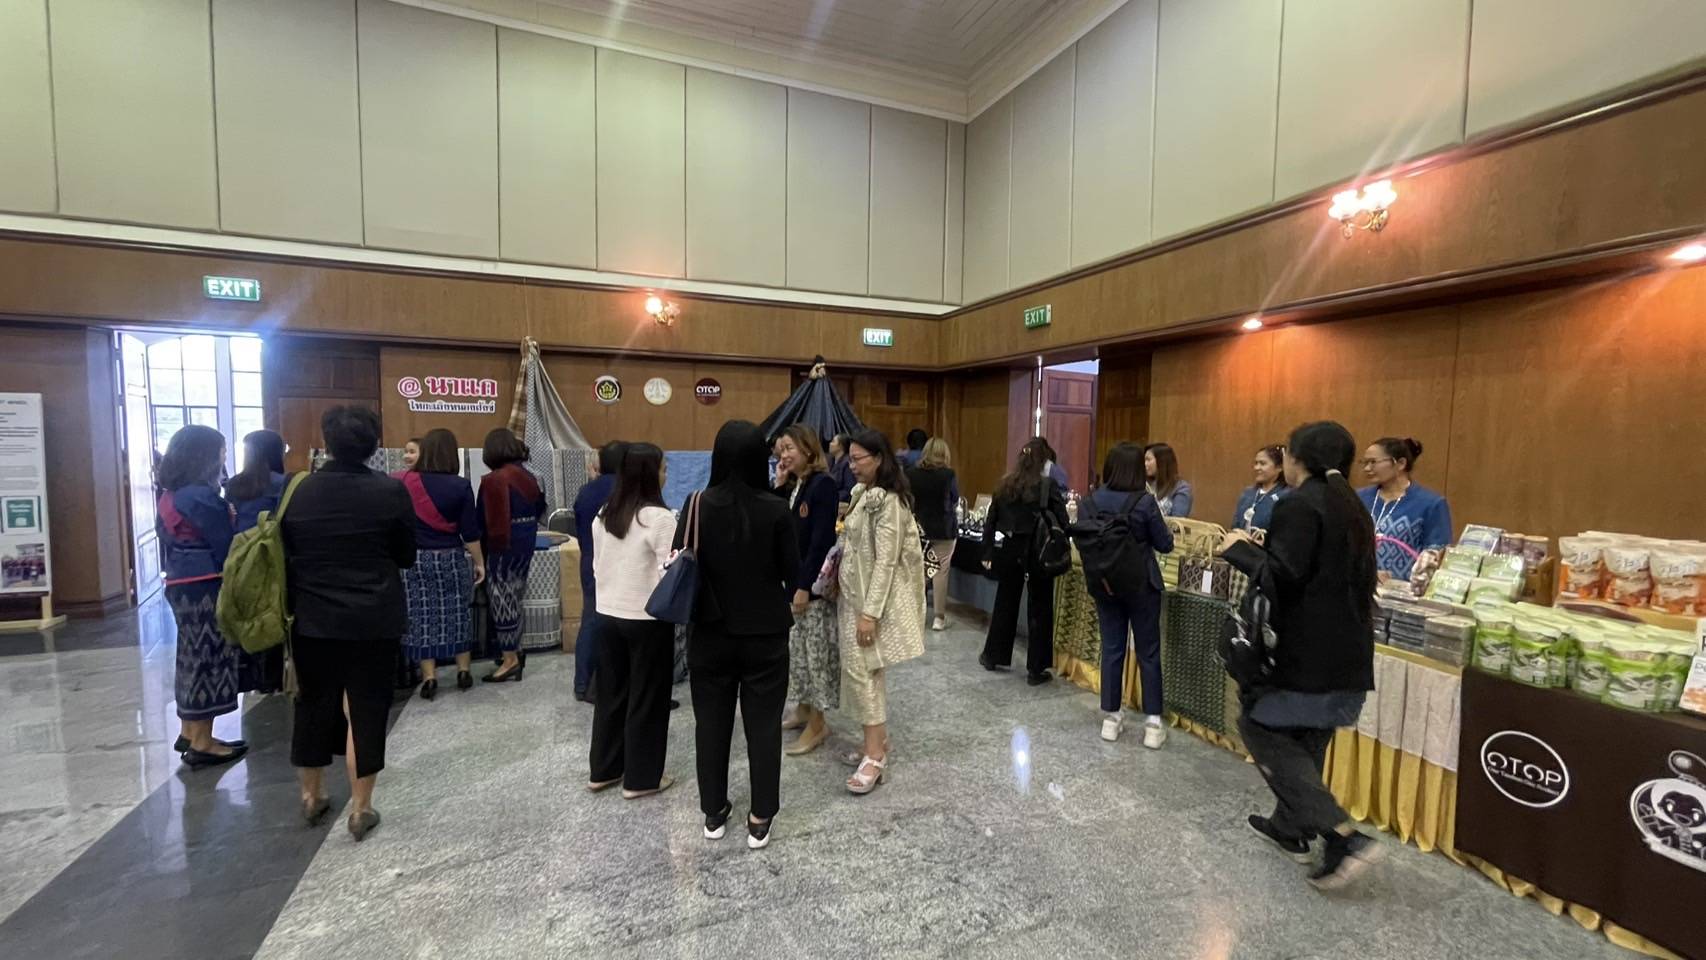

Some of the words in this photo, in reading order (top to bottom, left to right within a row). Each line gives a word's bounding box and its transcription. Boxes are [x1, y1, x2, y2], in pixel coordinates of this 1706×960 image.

[207, 279, 255, 297] EXIT
[1024, 309, 1045, 325] EXIT
[866, 331, 890, 344] EXIT
[696, 385, 720, 393] OTOP
[1487, 752, 1562, 785] OTOP
